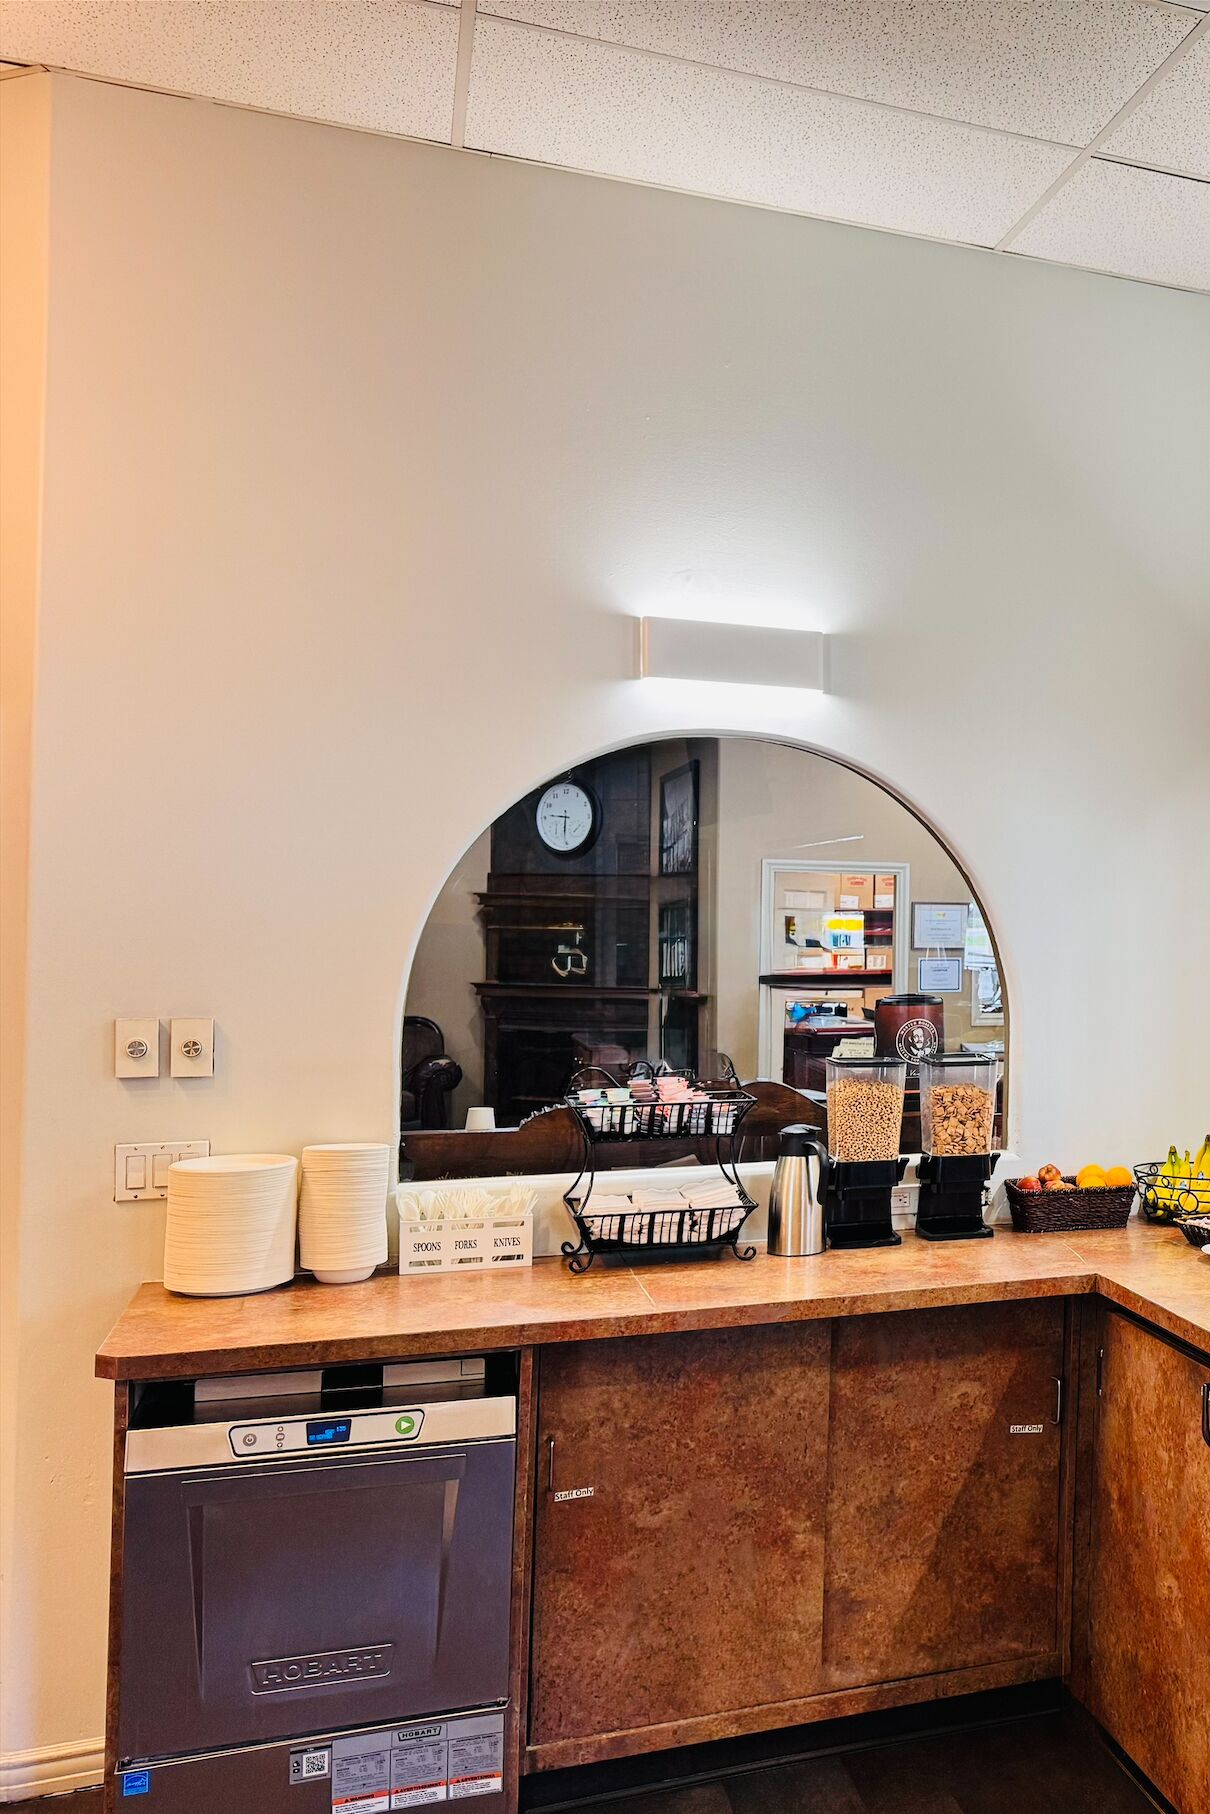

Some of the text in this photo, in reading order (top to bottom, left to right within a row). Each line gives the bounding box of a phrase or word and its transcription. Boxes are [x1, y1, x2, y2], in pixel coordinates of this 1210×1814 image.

[413, 1241, 442, 1253] SPOONS
[454, 1239, 477, 1250] FORKS
[493, 1237, 521, 1247] KNIVES
[1011, 1424, 1027, 1432] Staff
[555, 1487, 593, 1500] Staff Only
[262, 1653, 383, 1685] HOBART
[401, 1727, 438, 1739] HOBART
